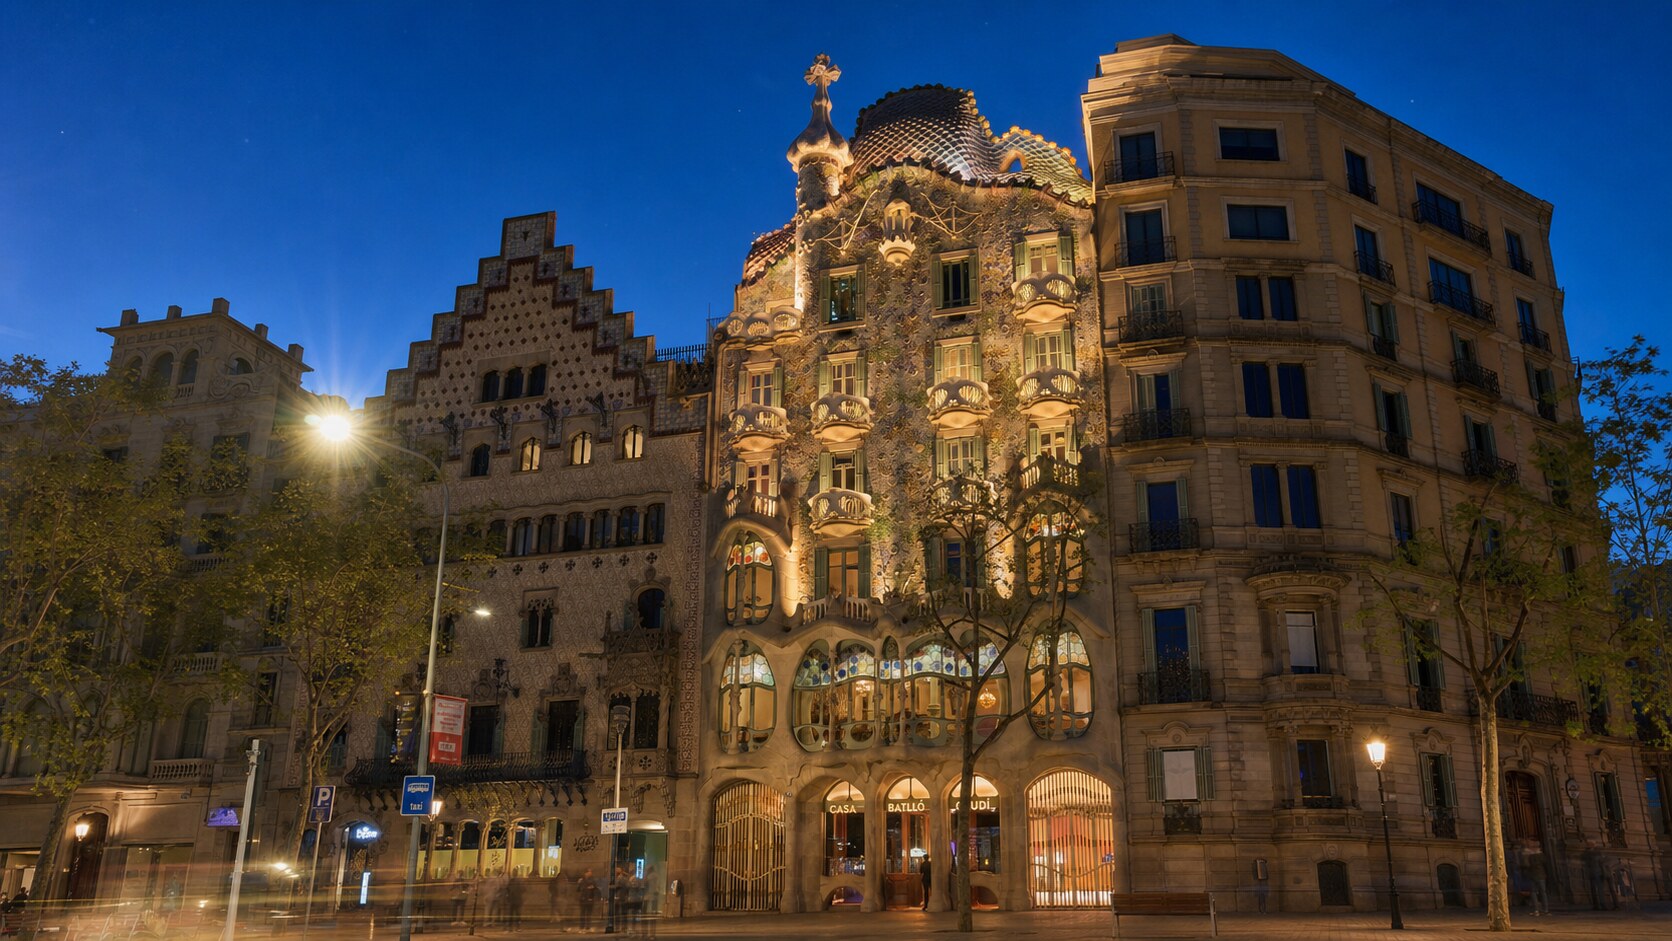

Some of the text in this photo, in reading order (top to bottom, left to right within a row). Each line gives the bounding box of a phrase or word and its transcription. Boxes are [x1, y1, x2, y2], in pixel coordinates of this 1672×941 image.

[317, 788, 331, 806] P
[829, 798, 990, 814] CASA BATLLÓ UDÍ
